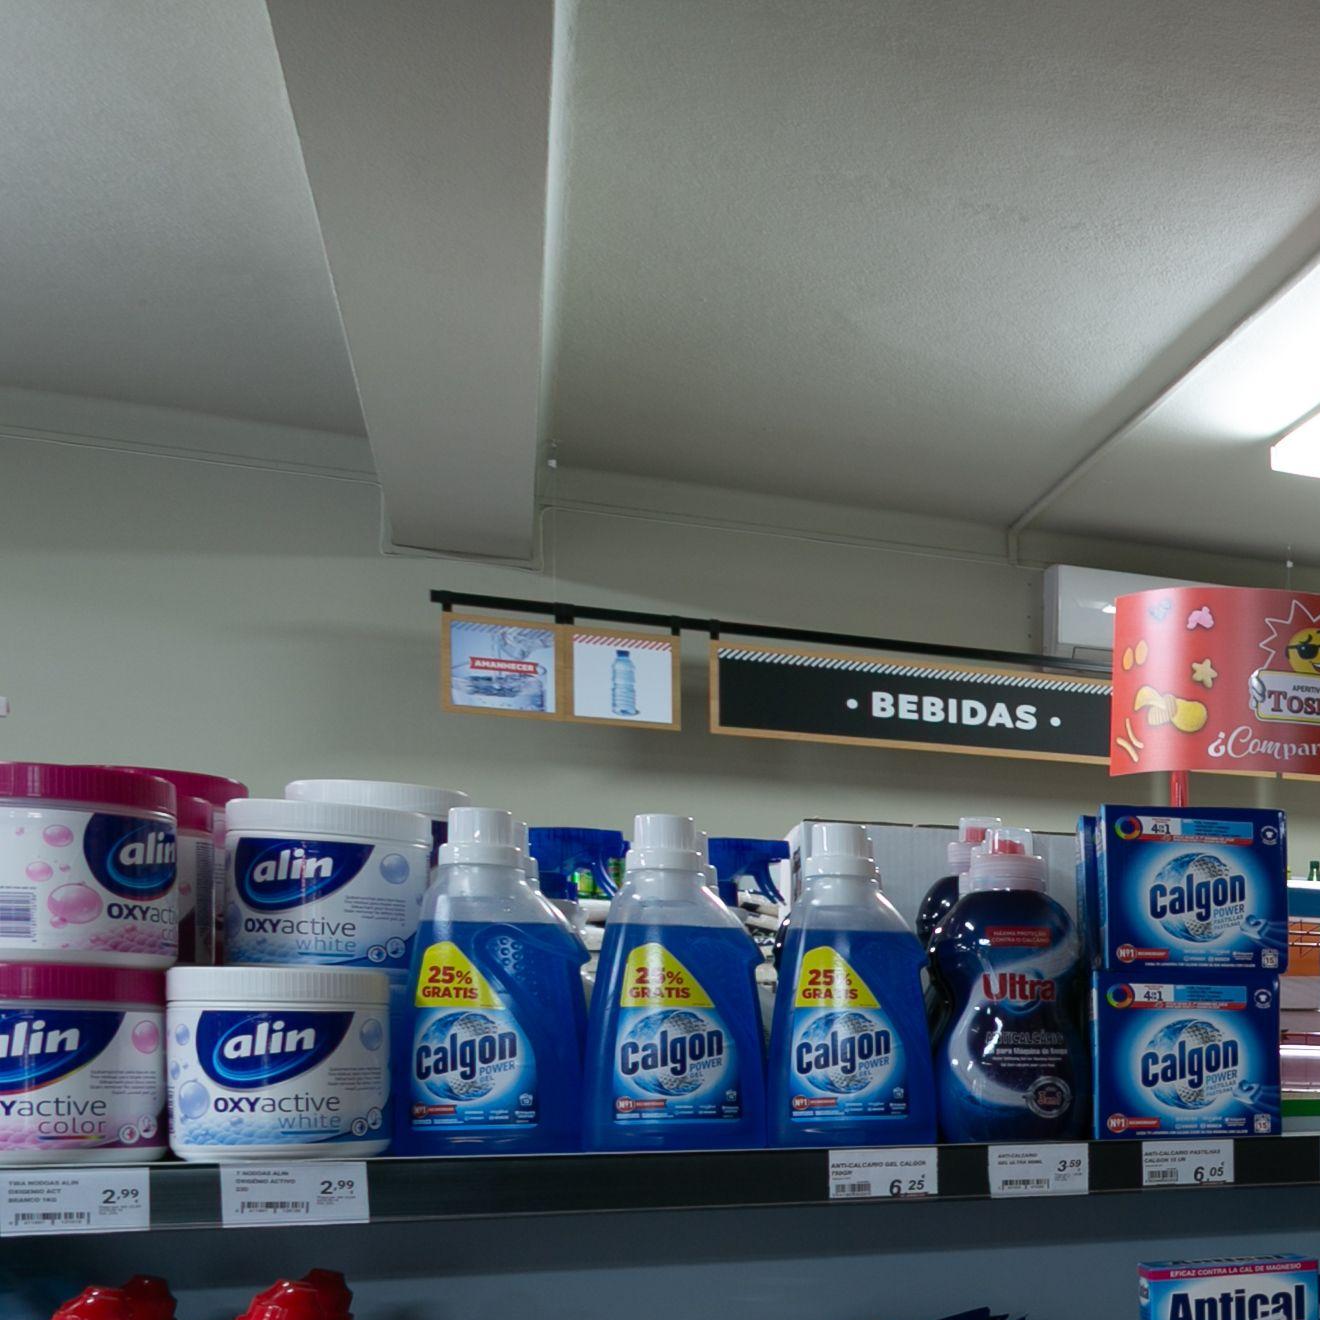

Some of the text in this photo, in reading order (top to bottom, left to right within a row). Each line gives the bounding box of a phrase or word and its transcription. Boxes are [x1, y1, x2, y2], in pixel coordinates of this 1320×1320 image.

[871, 692, 1038, 730] BEBIDAS
[253, 856, 334, 885] alin
[1150, 874, 1245, 922] Calgon
[243, 917, 356, 938] OXYactive
[295, 936, 356, 953] white
[428, 964, 472, 986] 25%
[635, 966, 684, 985] 25%
[422, 986, 479, 1000] GRATIS
[629, 984, 691, 1000] GRATIS
[802, 984, 859, 1000] GRATIS
[982, 974, 1056, 1001] Ultra
[224, 1022, 317, 1057] alin
[416, 1029, 517, 1079] Calgon
[620, 1028, 724, 1077] Calgon
[795, 1028, 891, 1078] Calgon
[478, 1062, 516, 1076] POWER
[688, 1058, 724, 1073] POWER
[1140, 1040, 1239, 1097] Calgon
[213, 1094, 341, 1115] OXYactive
[38, 1117, 106, 1134] color
[278, 1113, 342, 1131] white
[1057, 1159, 1082, 1172] 3,59
[101, 1188, 139, 1206] 2,99
[319, 1179, 355, 1196] 2,99
[1169, 1269, 1196, 1278] EFICAZ
[1197, 1267, 1229, 1276] CONTRA
[1231, 1266, 1240, 1274] LA
[1241, 1266, 1254, 1274] CAL
[1265, 1262, 1302, 1272] MAGNESIO
